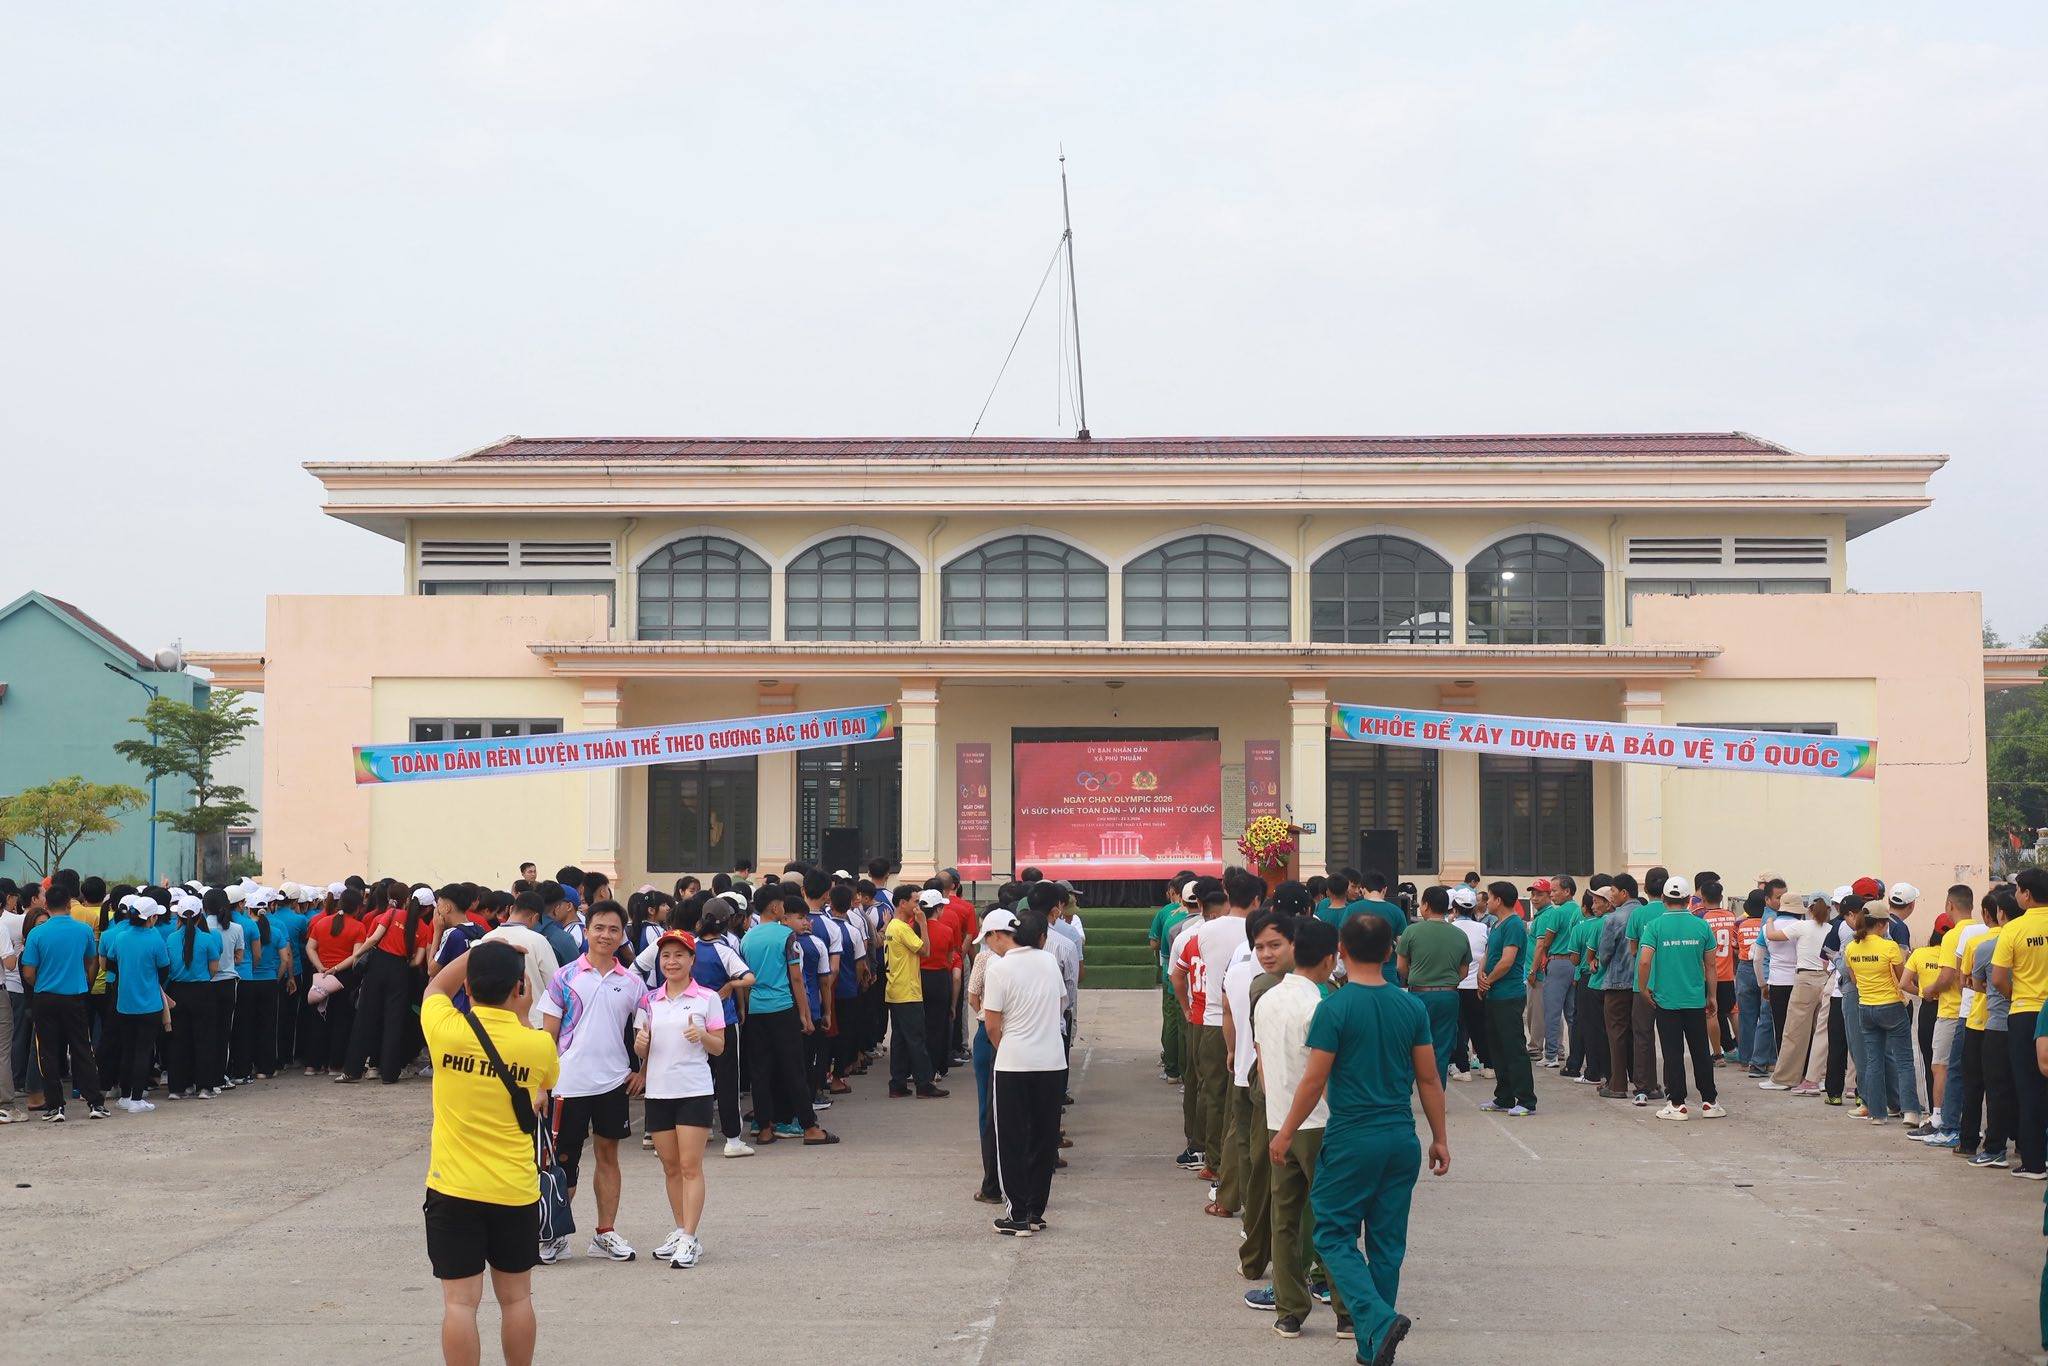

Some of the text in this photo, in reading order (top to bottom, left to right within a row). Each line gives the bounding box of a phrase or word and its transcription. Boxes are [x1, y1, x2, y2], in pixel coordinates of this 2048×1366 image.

[391, 717, 866, 774] TOÀN DÂN RÈN LUYỆN THÂN THỂ THEO GƯƠNG BÁC HỒ VĨ ĐẠI
[1360, 714, 1839, 768] KHỎE ĐỂ XÂY DỰNG VÀ BẢO VỆ TỔ QUỐC
[1114, 795, 1152, 803] OLYMPIC
[1153, 795, 1173, 803] 2026
[1715, 929, 1730, 957] 9
[2026, 934, 2044, 947] PHÚ
[442, 1053, 475, 1073] PHÚ
